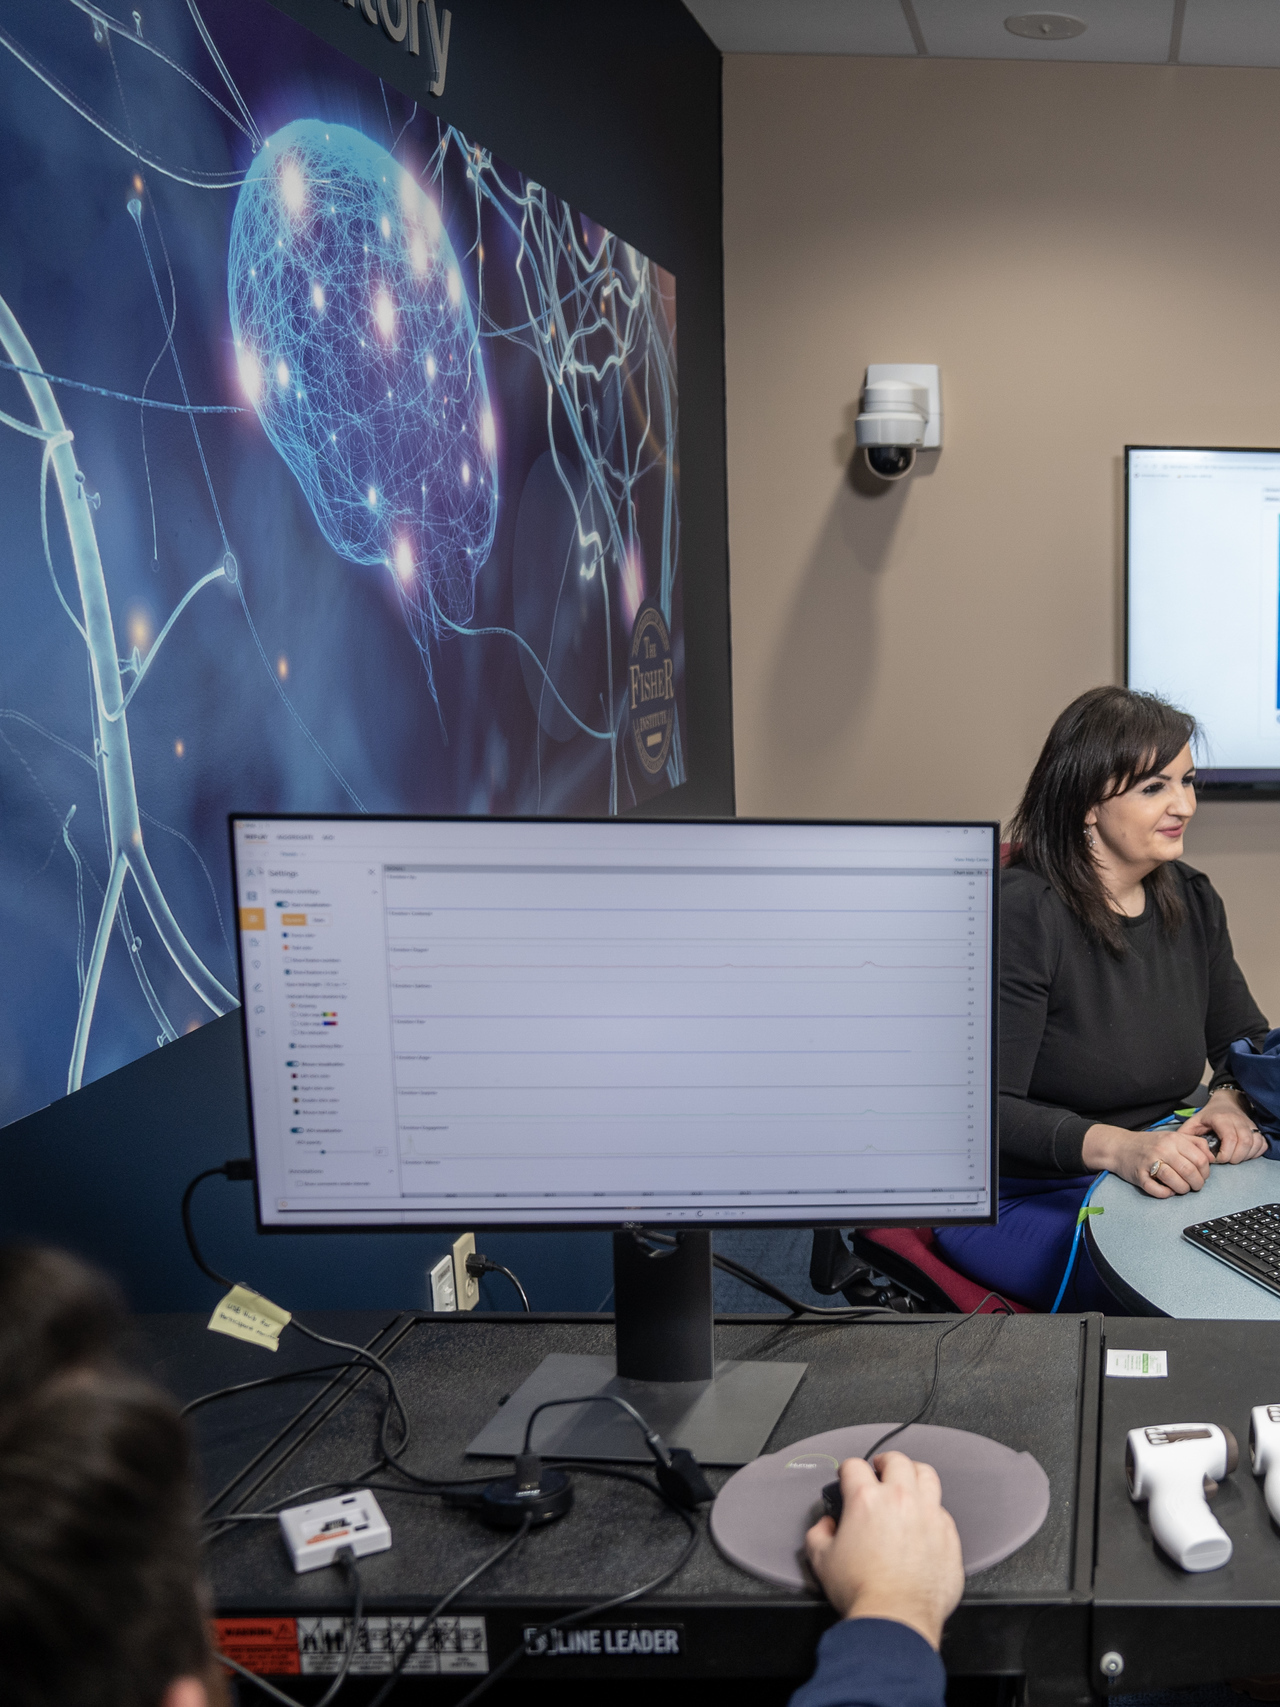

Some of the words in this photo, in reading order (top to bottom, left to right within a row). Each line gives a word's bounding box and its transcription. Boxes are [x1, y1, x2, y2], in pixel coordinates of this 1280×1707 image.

[629, 658, 675, 710] FISHER
[269, 869, 299, 878] Settings
[557, 1629, 600, 1654] LINE
[604, 1629, 680, 1654] LEADER
